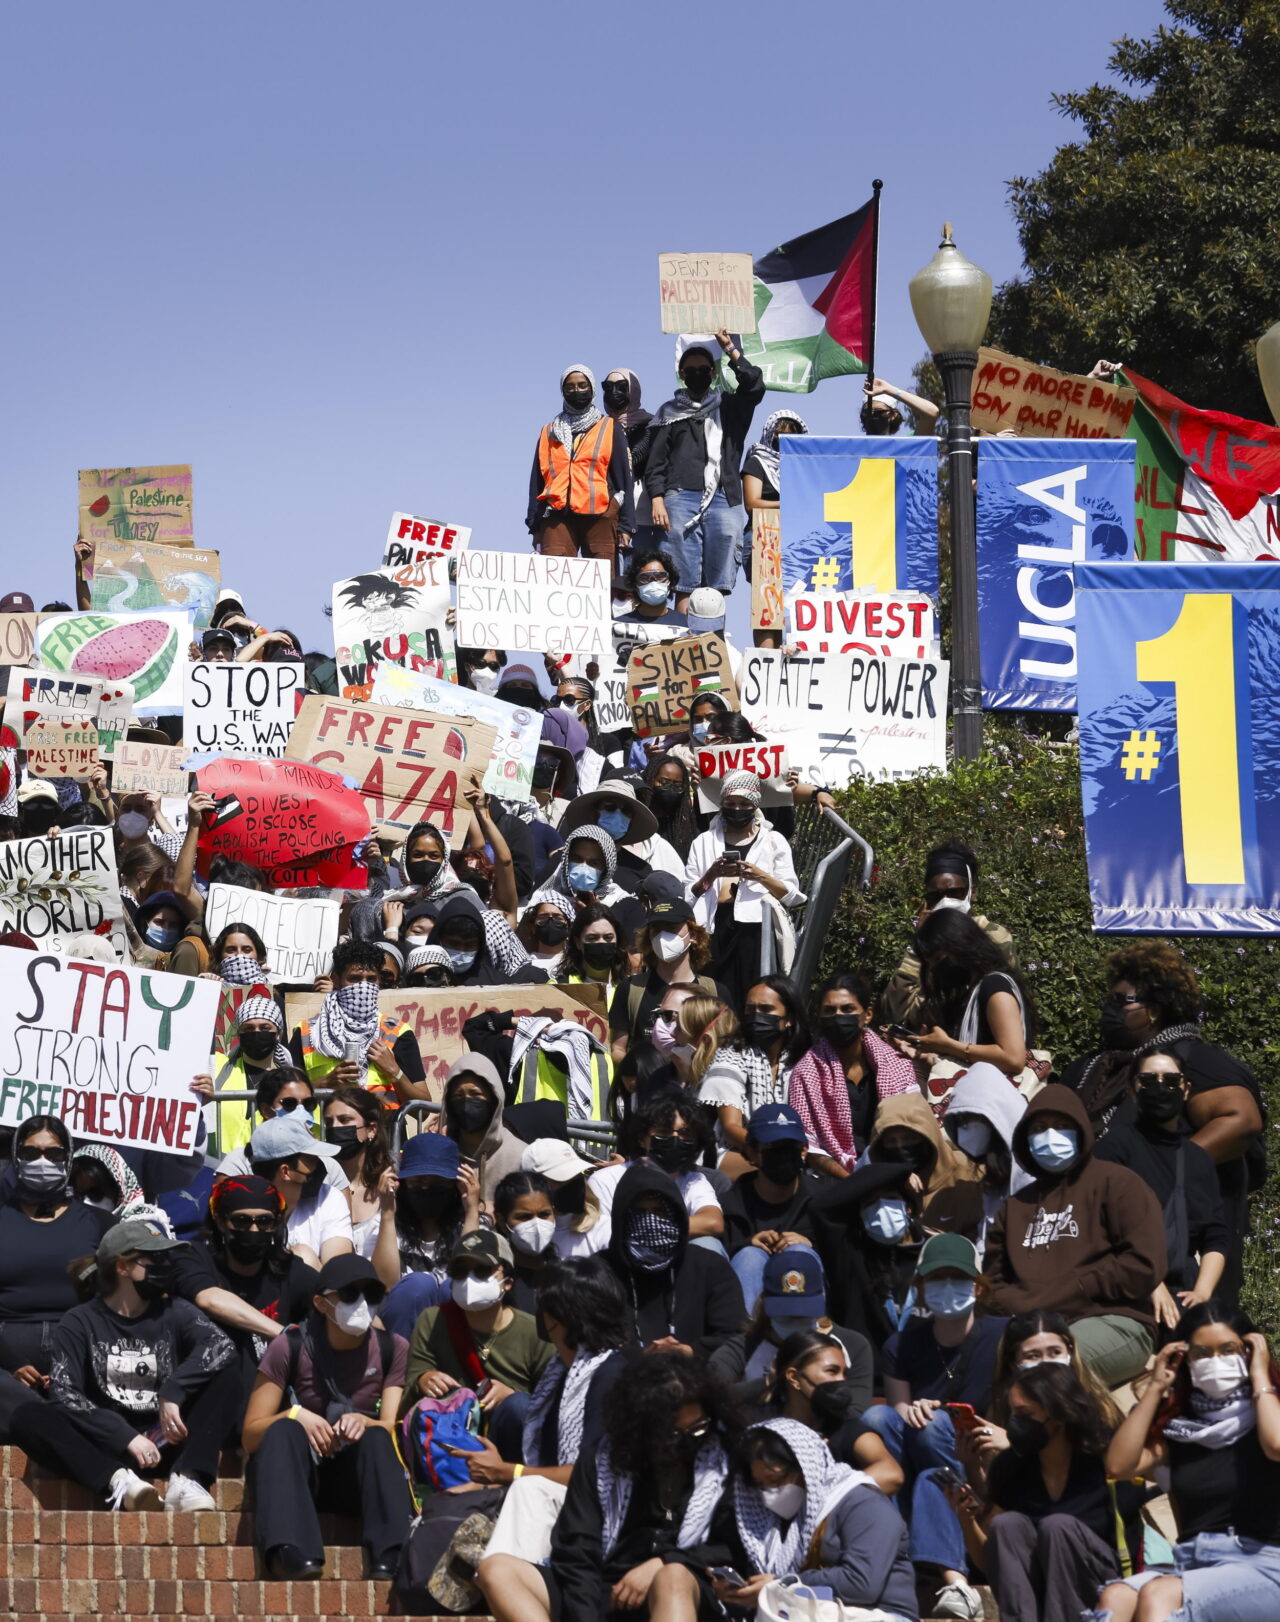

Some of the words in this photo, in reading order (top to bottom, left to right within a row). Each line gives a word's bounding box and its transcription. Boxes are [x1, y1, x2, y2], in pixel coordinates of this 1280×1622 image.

[663, 258, 709, 278] JEWS
[718, 261, 738, 274] for
[978, 362, 1021, 387] NO
[1023, 371, 1086, 405] MORE
[972, 393, 1011, 416] ON
[130, 488, 185, 508] Palestine
[397, 518, 457, 551] FREE
[513, 555, 538, 585] LA
[1016, 465, 1087, 678] UCLA
[546, 590, 603, 621] CON
[795, 600, 929, 639] DIVEST
[39, 614, 120, 673] FREE
[459, 620, 500, 648] LOS
[515, 623, 541, 651] DE
[545, 625, 605, 653] GAZA
[641, 641, 723, 682] SIKHS
[22, 677, 93, 709] FREE
[191, 664, 298, 709] STOP
[661, 678, 689, 696] for
[744, 656, 825, 711] STATE
[848, 659, 938, 720] POWER
[229, 709, 263, 723] THE
[29, 732, 59, 745] FREE
[64, 732, 97, 745] FREE
[196, 722, 245, 747] U.S.
[316, 706, 435, 760] FREE
[121, 744, 184, 771] LOVE
[698, 744, 785, 781] DIVEST
[247, 794, 312, 814] DIVEST
[246, 814, 318, 831] DISCLOSE
[211, 832, 269, 849] ABOLISH
[278, 830, 346, 848] POLICING
[255, 850, 283, 865] THE
[208, 887, 330, 951] PROTECT
[45, 937, 63, 953] IS
[15, 955, 197, 1052] STAY
[2, 1024, 159, 1096] STRONG
